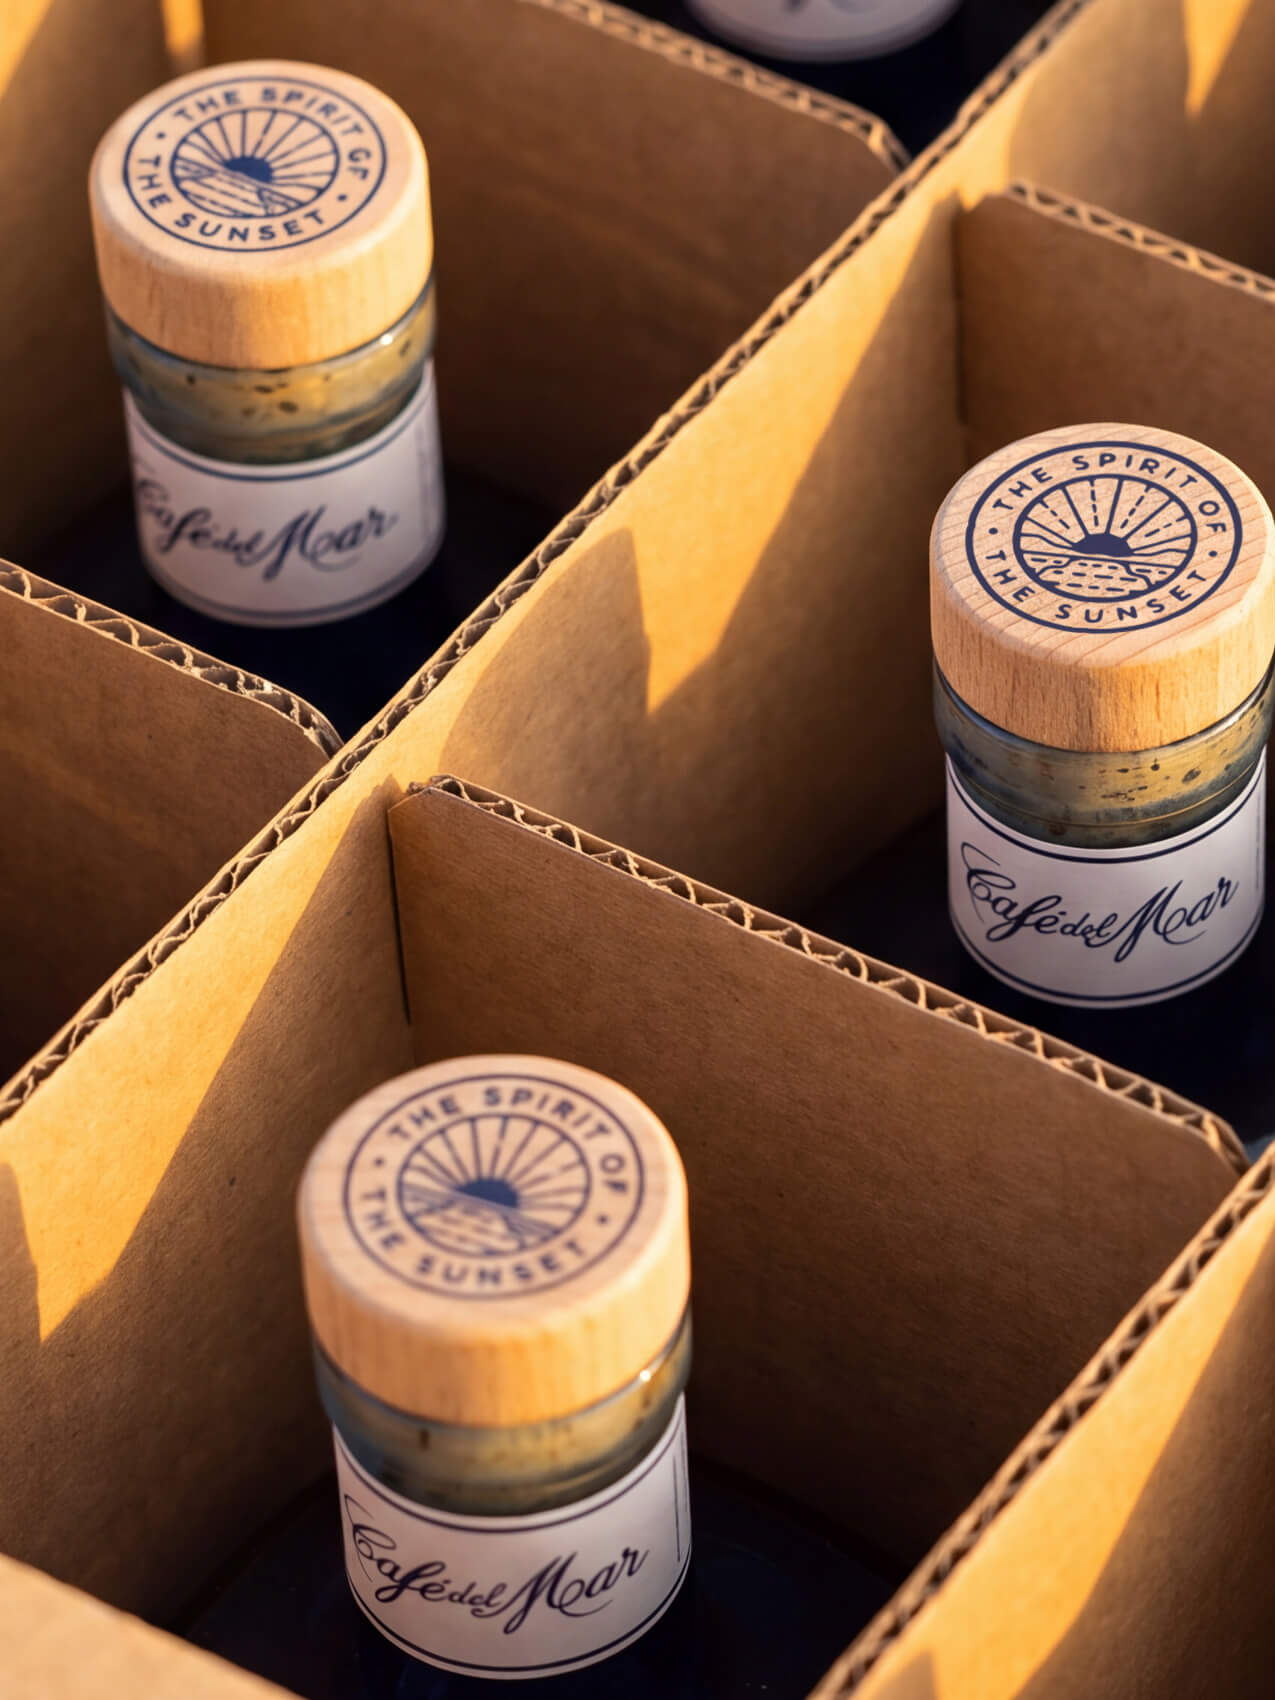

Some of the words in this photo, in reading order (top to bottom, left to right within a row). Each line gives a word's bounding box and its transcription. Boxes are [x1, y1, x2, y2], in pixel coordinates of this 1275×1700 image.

[173, 87, 243, 123] THE
[260, 86, 364, 141] SPIRIT
[138, 154, 173, 209] THE
[173, 208, 326, 242] SUNSET
[992, 466, 1054, 513] THE
[1071, 452, 1199, 490] SPIRIT
[1197, 499, 1228, 535] OF
[235, 504, 398, 582] Mar
[985, 549, 1037, 605] THE
[1054, 569, 1209, 624] SUNSET
[960, 841, 1067, 943] Café
[1059, 912, 1119, 937] del
[1084, 876, 1240, 963] Mar
[386, 1094, 462, 1141] THE
[483, 1086, 612, 1142] SPIRIT
[599, 1152, 630, 1195] OF
[361, 1186, 407, 1252] THE
[413, 1239, 587, 1287] SUNSET
[343, 1493, 449, 1603] Café
[471, 1545, 651, 1635] Mar
[447, 1581, 508, 1608] del
